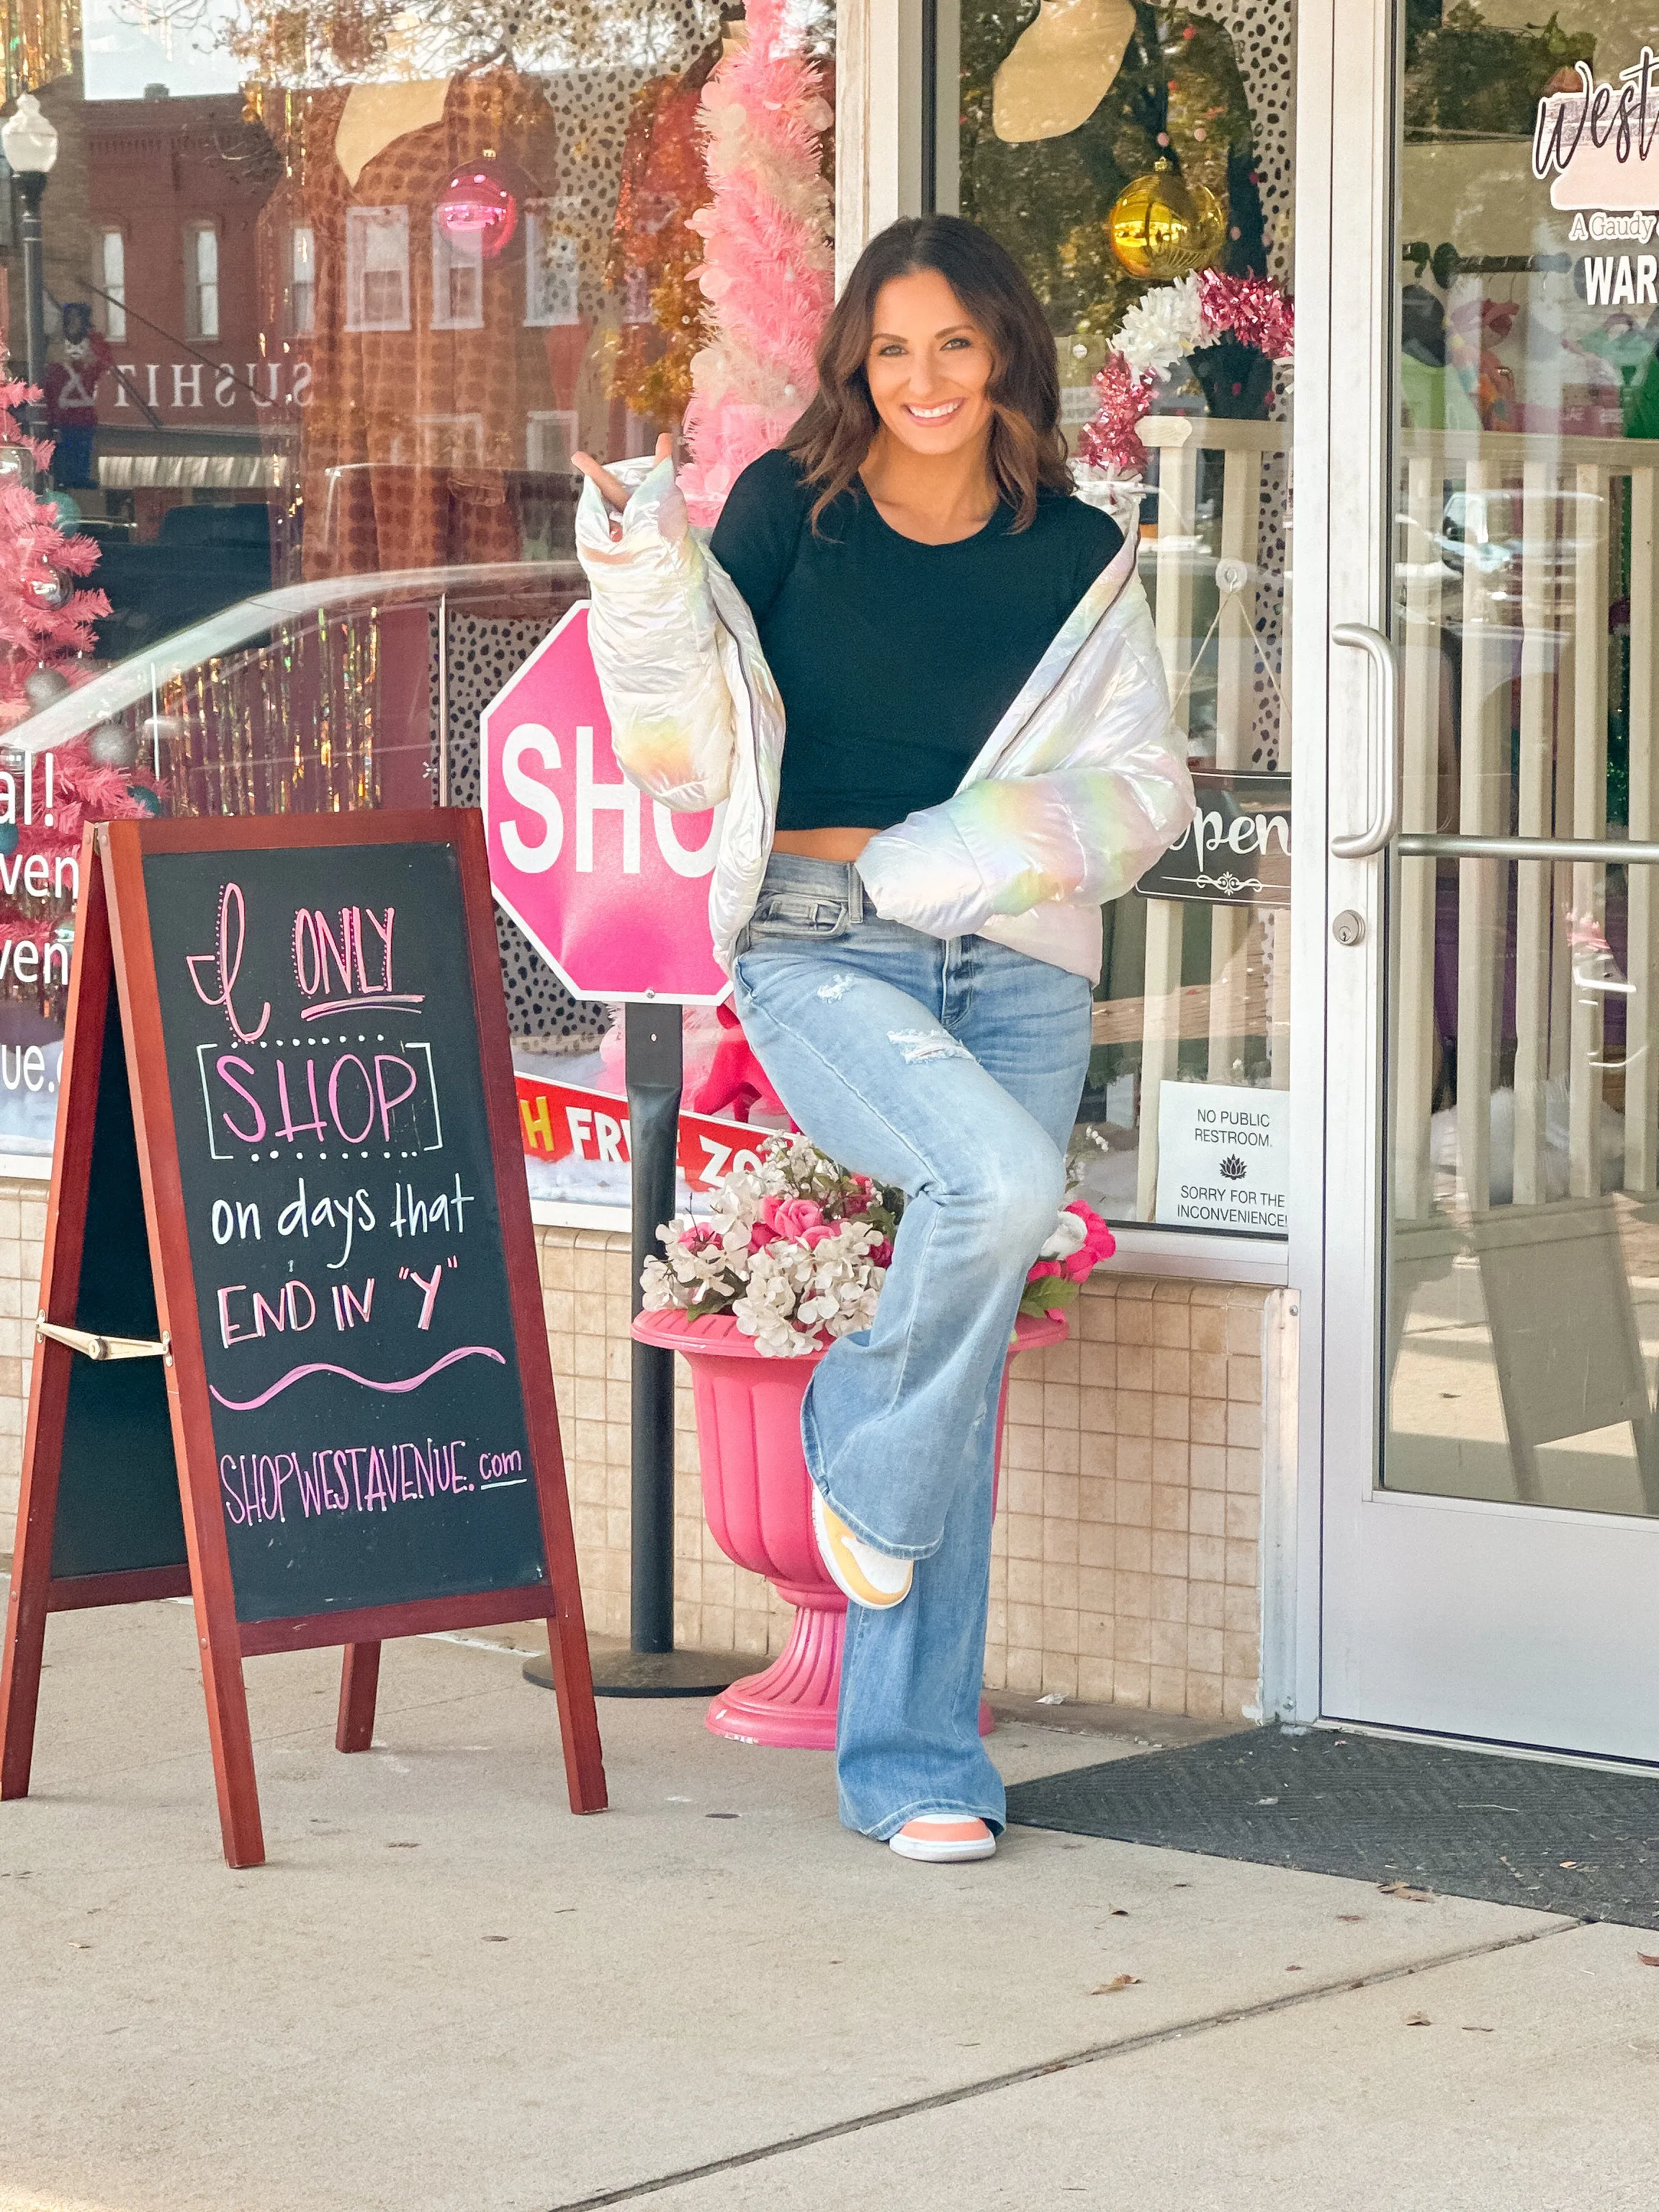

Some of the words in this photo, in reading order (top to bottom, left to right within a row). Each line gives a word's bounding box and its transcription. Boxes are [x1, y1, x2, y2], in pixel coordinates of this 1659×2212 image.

[1571, 216, 1587, 238] A
[1591, 214, 1654, 242] Gaudy
[1583, 254, 1659, 306] WAR
[1169, 806, 1292, 873] pen
[292, 905, 395, 997] ONLY
[1, 1044, 63, 1093] ue.
[217, 1054, 417, 1143] SHOP
[1197, 1109, 1216, 1123] NO
[1220, 1111, 1270, 1127] PUBLIC
[698, 1133, 774, 1190] ZO
[1194, 1128, 1273, 1148] RESTROOM.
[212, 1197, 261, 1245] on
[277, 1177, 376, 1269] days
[390, 1173, 475, 1237] that
[1177, 1204, 1287, 1227] INCONVENIENCE!
[1180, 1185, 1226, 1202] SORRY
[1231, 1190, 1256, 1205] FOR
[1260, 1193, 1285, 1208] THE
[217, 1280, 317, 1349] END
[331, 1277, 375, 1331] IN
[398, 1255, 459, 1331] "Y"
